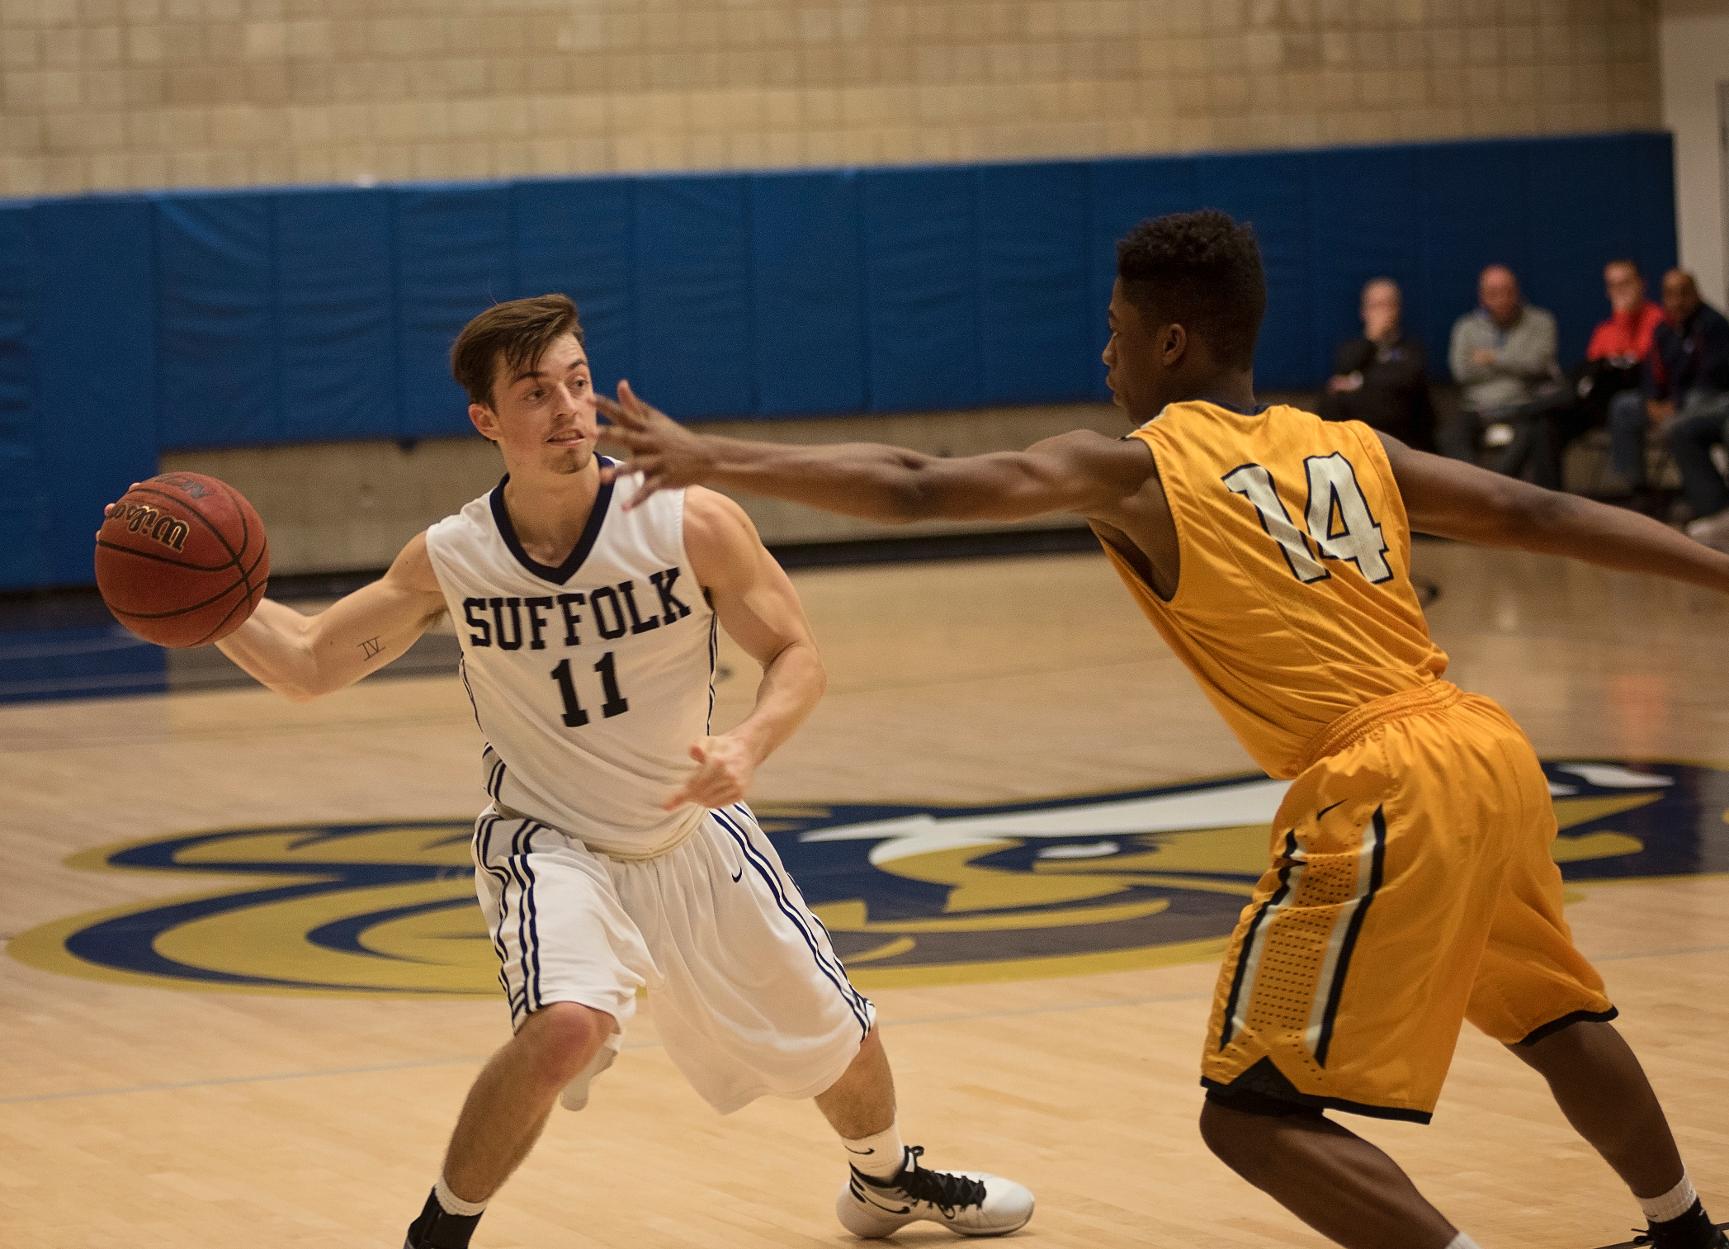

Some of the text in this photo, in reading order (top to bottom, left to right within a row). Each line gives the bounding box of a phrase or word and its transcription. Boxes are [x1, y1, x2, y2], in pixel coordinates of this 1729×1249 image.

[106, 502, 190, 553] Wilso
[1221, 451, 1394, 584] 14
[462, 567, 692, 651] SUFFOLK
[357, 635, 386, 662] IV
[550, 651, 629, 728] 11
